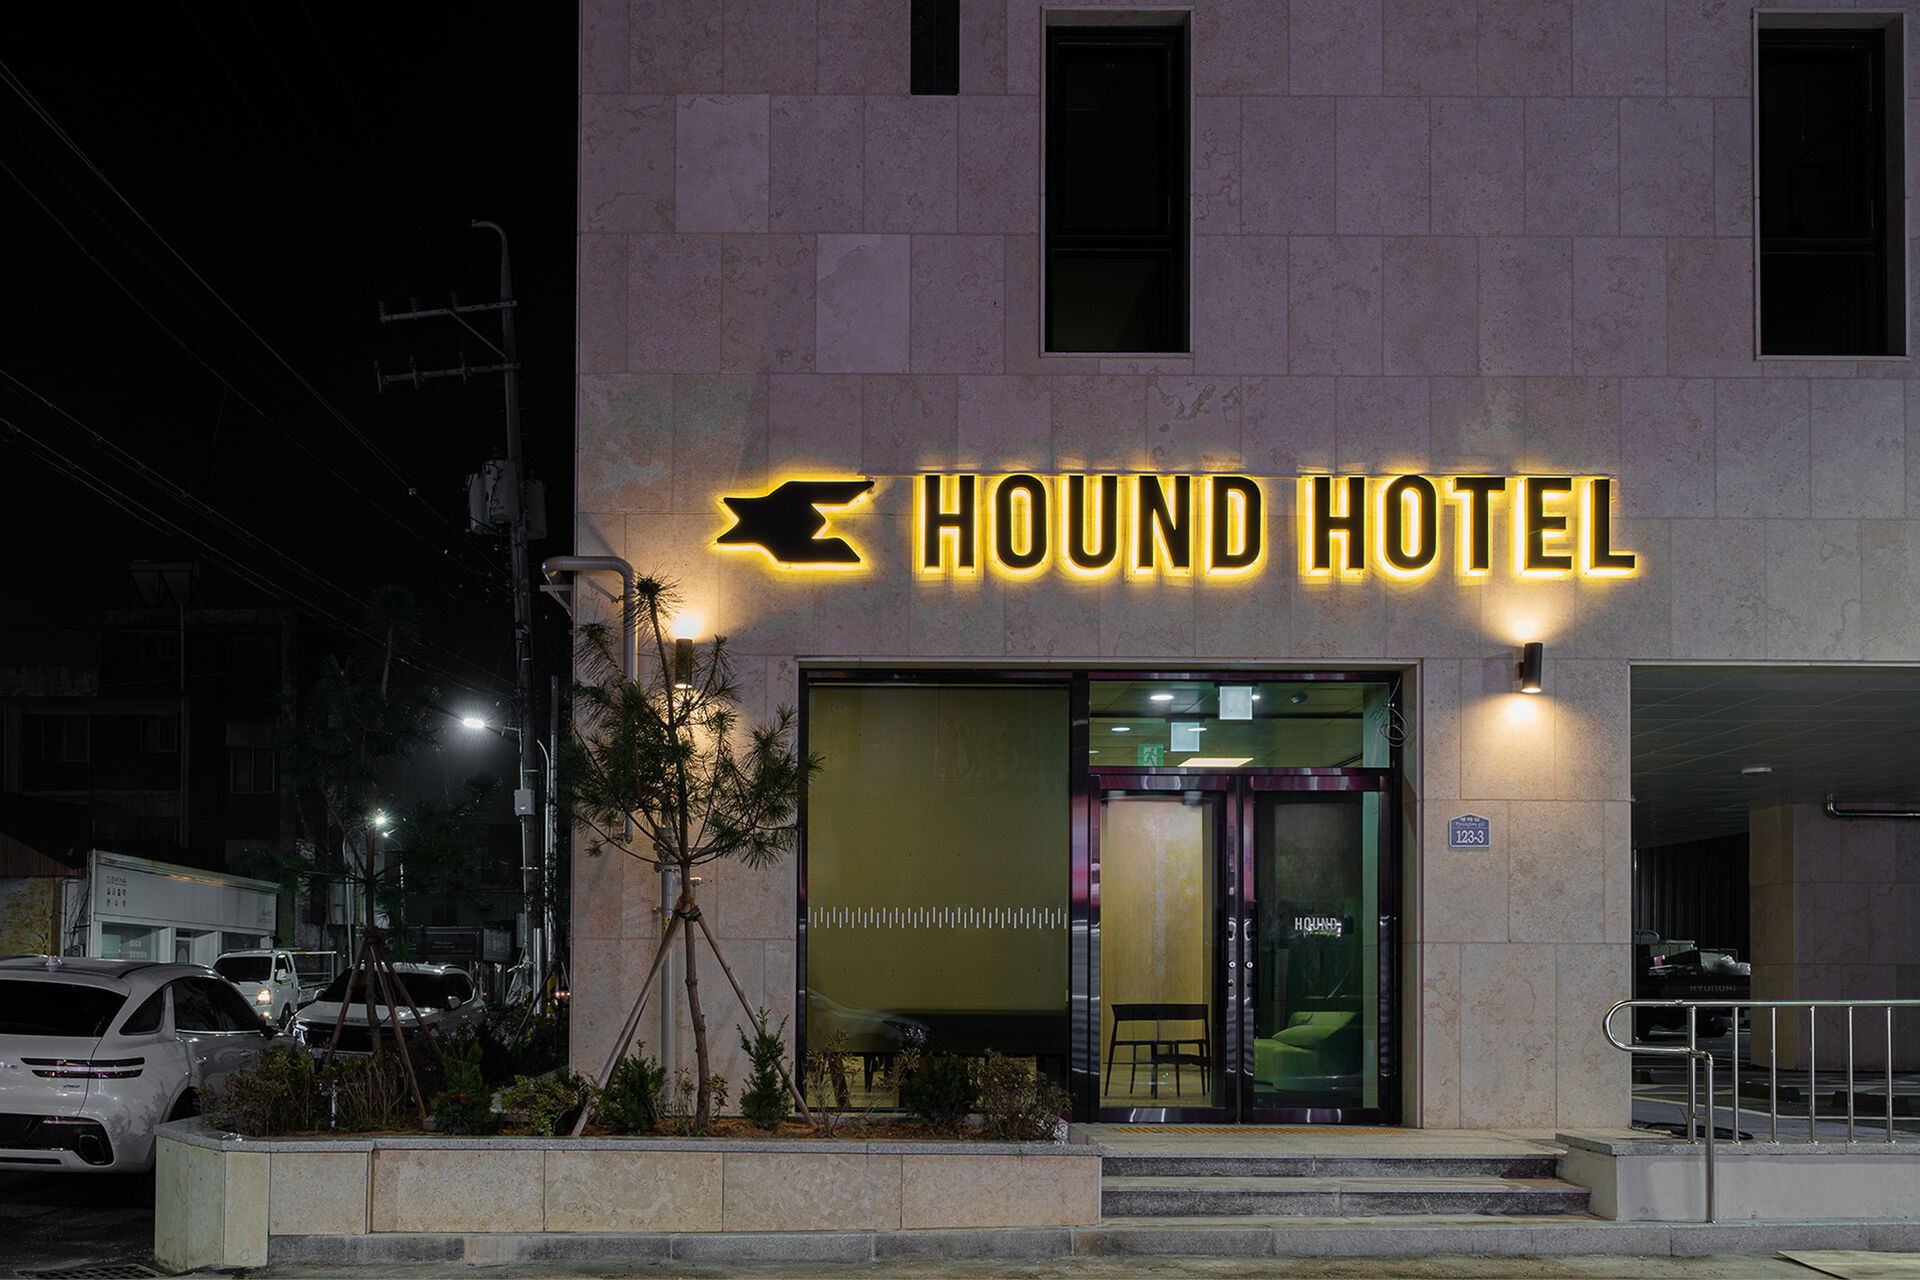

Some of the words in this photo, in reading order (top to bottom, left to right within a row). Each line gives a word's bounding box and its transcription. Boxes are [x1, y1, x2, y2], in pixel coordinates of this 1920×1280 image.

[923, 474, 1262, 570] HOUND
[1313, 475, 1637, 571] HOTEL
[1456, 830, 1484, 844] 123-3
[1294, 917, 1338, 931] HOUND
